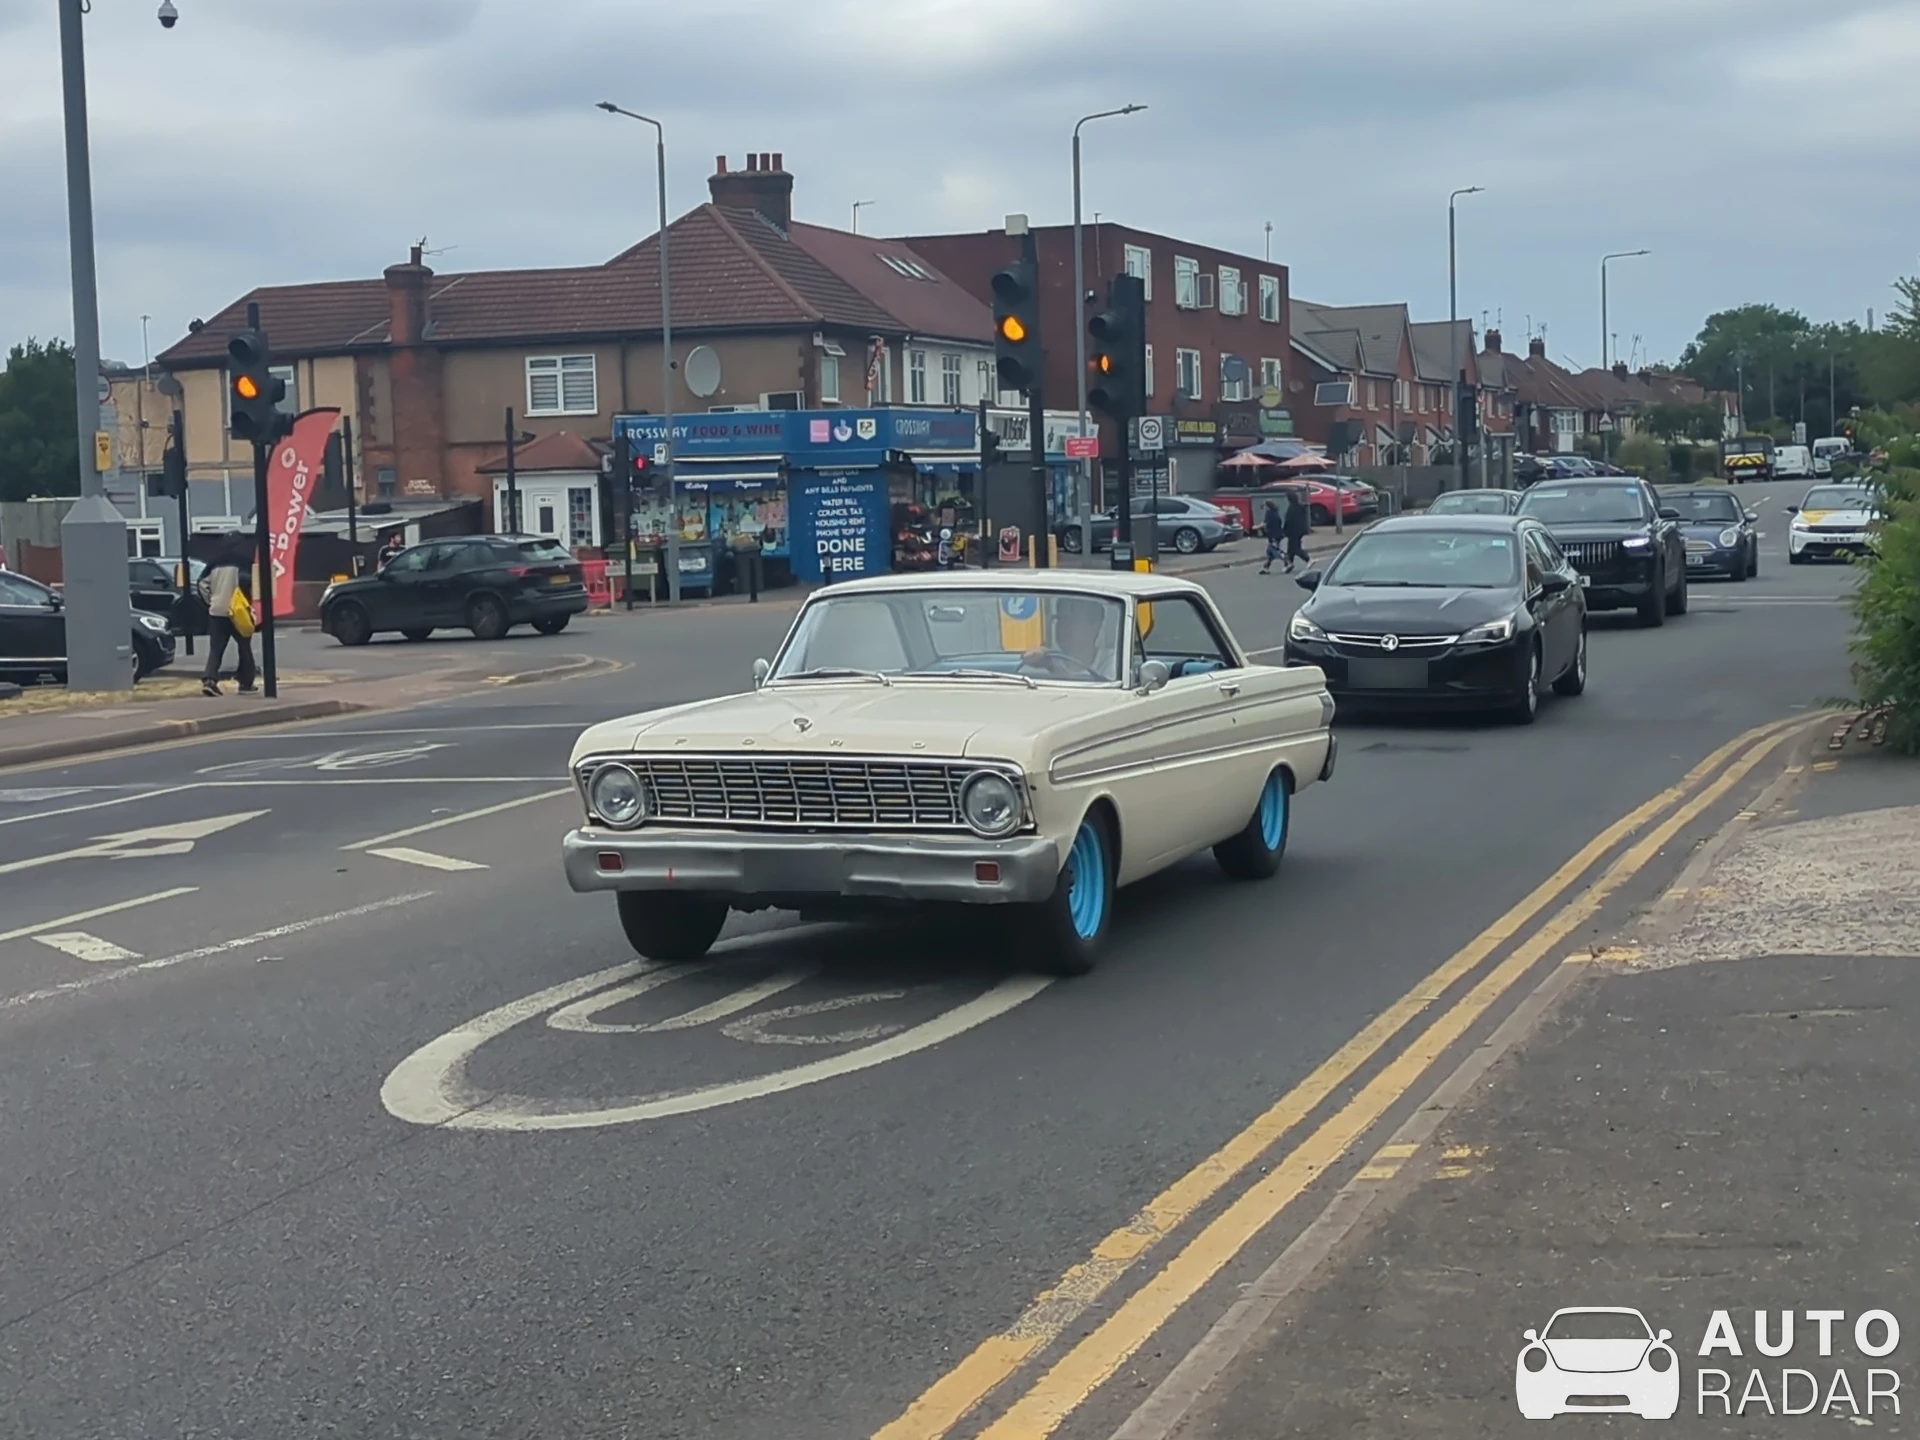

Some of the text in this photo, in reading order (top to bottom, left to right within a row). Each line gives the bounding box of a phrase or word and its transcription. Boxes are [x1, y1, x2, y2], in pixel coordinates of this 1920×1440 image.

[620, 425, 689, 440] ROSSWAY
[692, 424, 729, 437] FOOD
[746, 422, 781, 435] WINE
[1144, 424, 1157, 434] 20
[804, 487, 820, 495] ANY
[821, 498, 844, 506] WATER
[817, 507, 864, 517] COUNCIL TAX
[815, 517, 866, 527] HOUSING RENT
[816, 527, 866, 537] PHONE TOP UP
[817, 538, 866, 554] DONE
[674, 738, 926, 750] FORD
